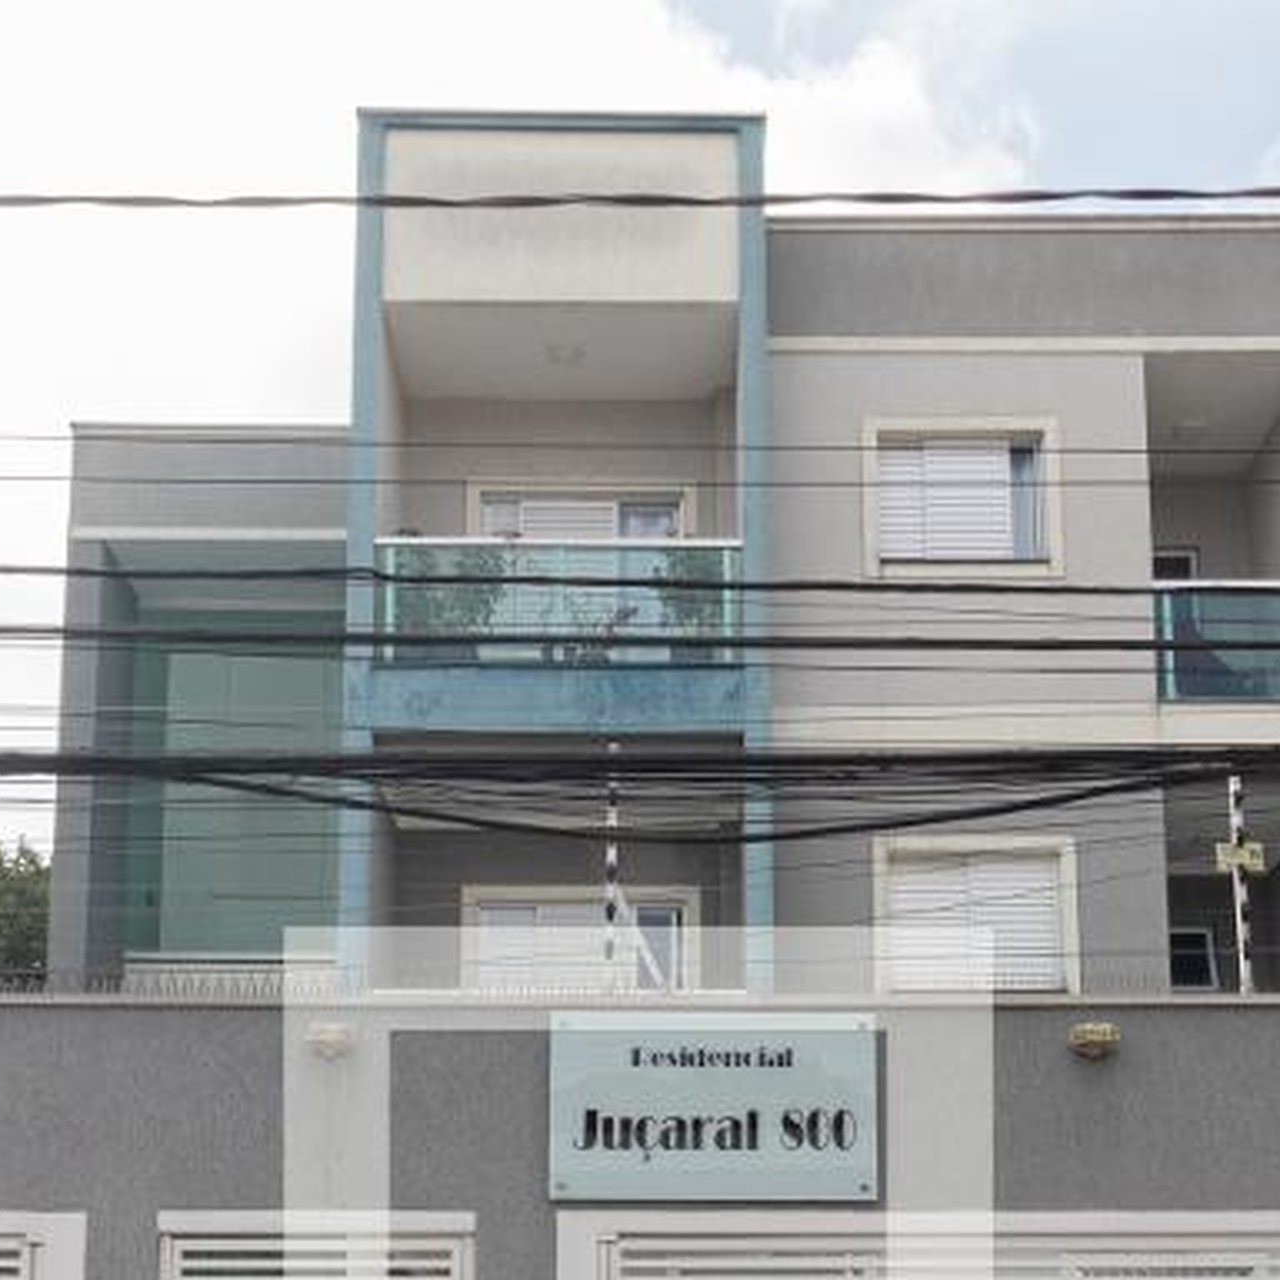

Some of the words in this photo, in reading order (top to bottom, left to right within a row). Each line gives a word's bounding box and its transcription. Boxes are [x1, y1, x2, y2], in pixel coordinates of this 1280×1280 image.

[630, 1045, 795, 1068] Residencial
[572, 1107, 760, 1162] Juçaral
[779, 1106, 858, 1151] 800
